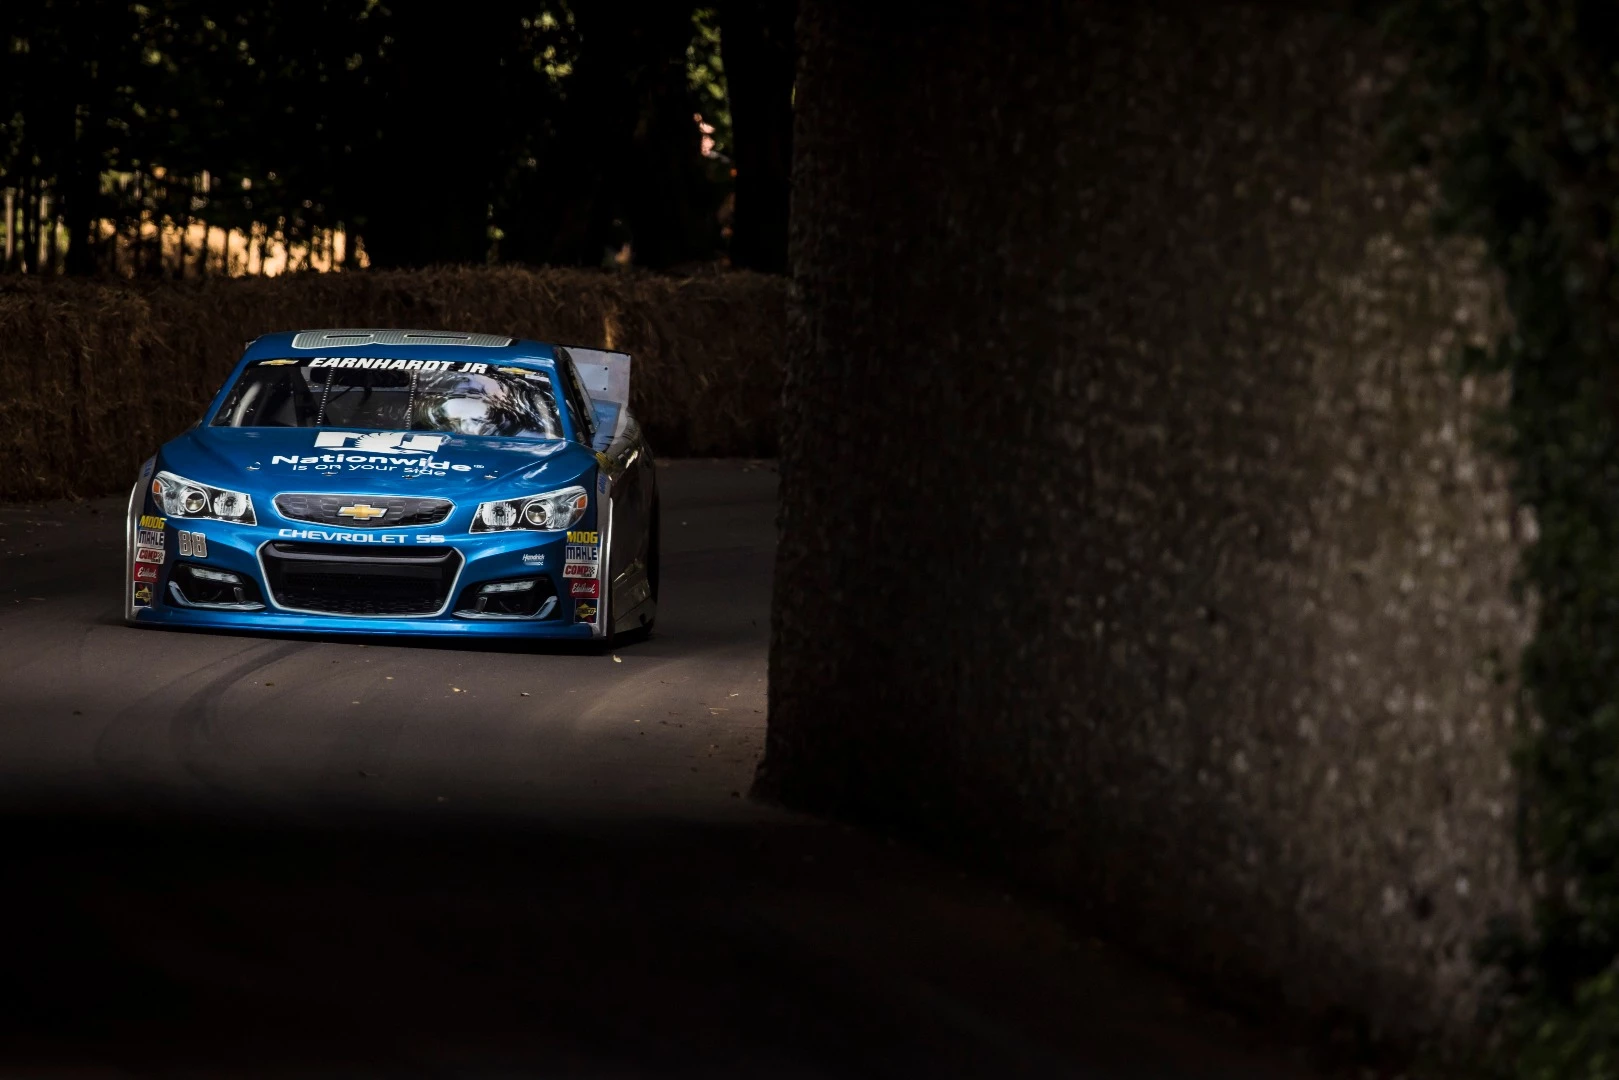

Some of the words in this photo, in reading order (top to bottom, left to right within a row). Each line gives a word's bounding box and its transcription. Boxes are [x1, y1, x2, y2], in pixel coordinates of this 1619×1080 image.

[308, 357, 453, 371] EARNHARDT
[458, 362, 488, 374] JR
[271, 454, 473, 472] Nationwide
[348, 464, 398, 472] your
[403, 467, 447, 477] side
[139, 515, 166, 529] MOOG
[139, 530, 165, 546] MAHLE
[178, 529, 208, 558] 88
[278, 528, 409, 544] CHEVROLET
[416, 534, 446, 544] SS
[566, 531, 599, 544] MOOG
[566, 547, 598, 561] MAHLE
[565, 564, 589, 575] COMP
